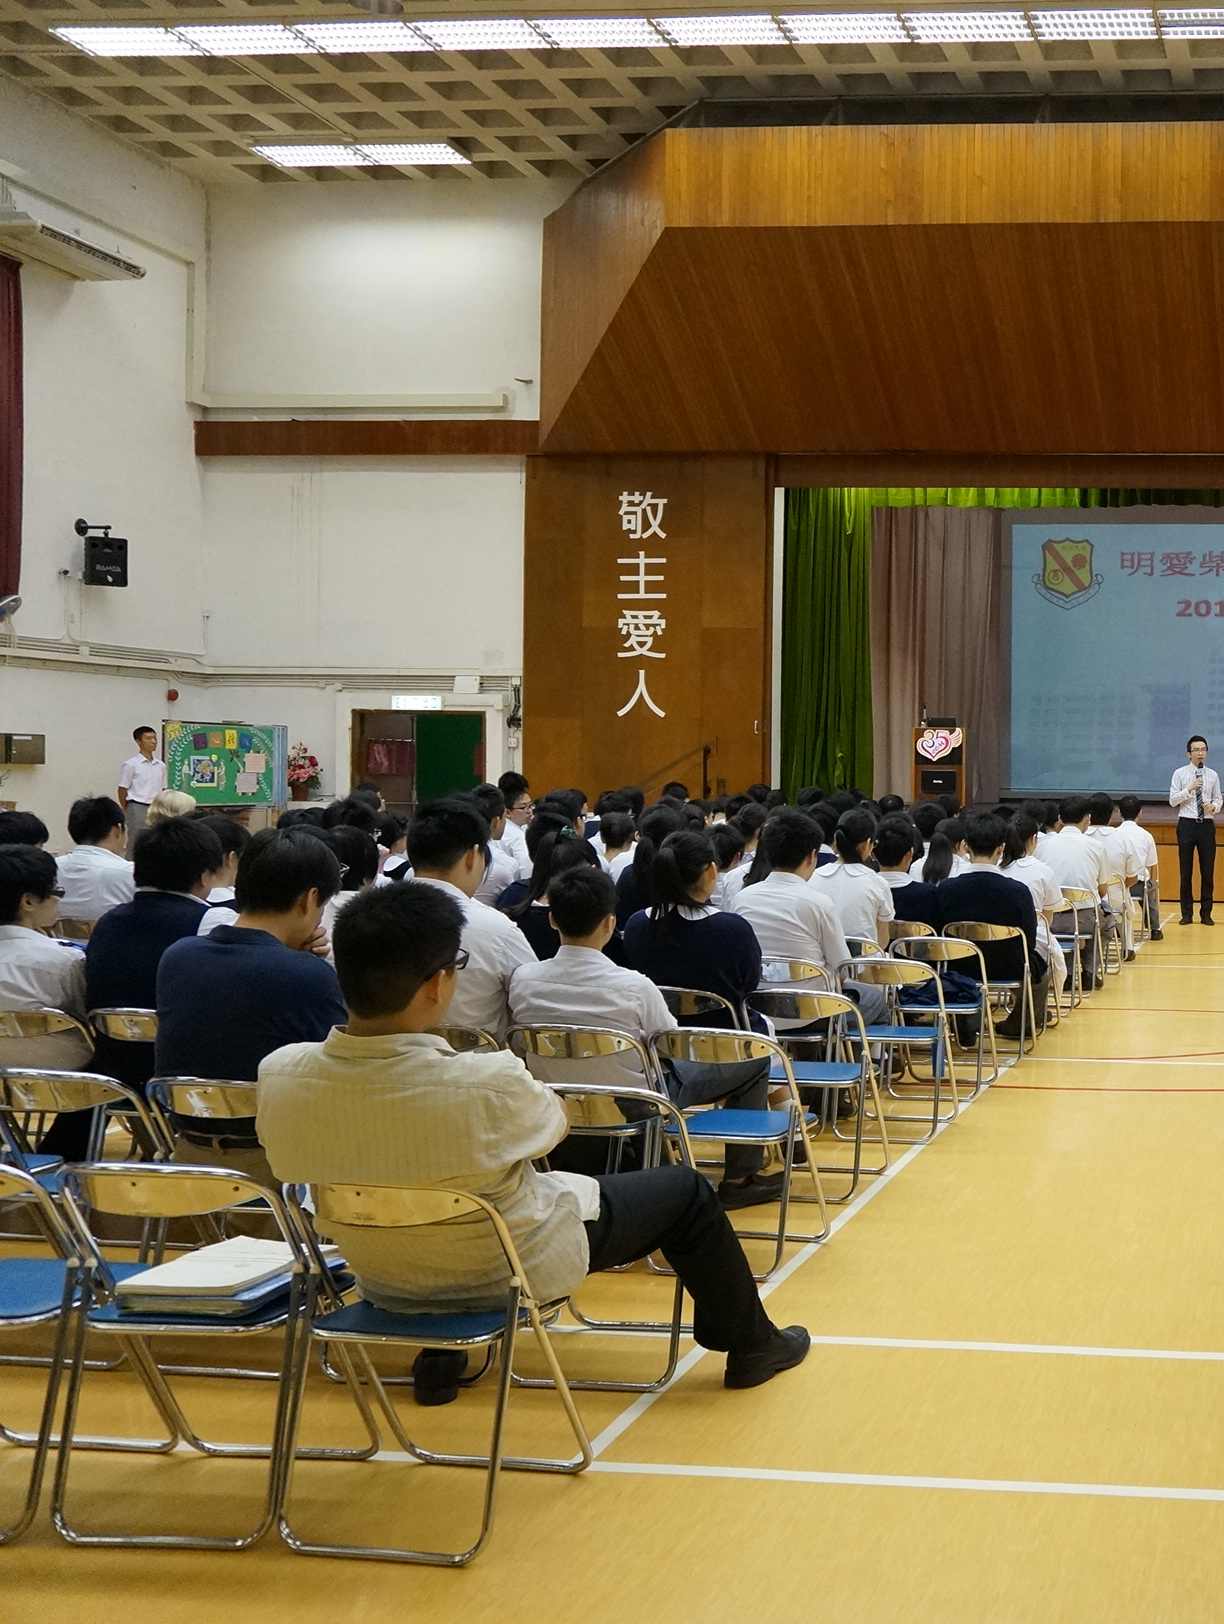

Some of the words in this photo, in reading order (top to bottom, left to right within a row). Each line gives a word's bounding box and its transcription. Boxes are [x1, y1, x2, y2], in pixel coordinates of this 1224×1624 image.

[616, 491, 668, 718] 敬主愛人
[396, 697, 419, 708] EXT
